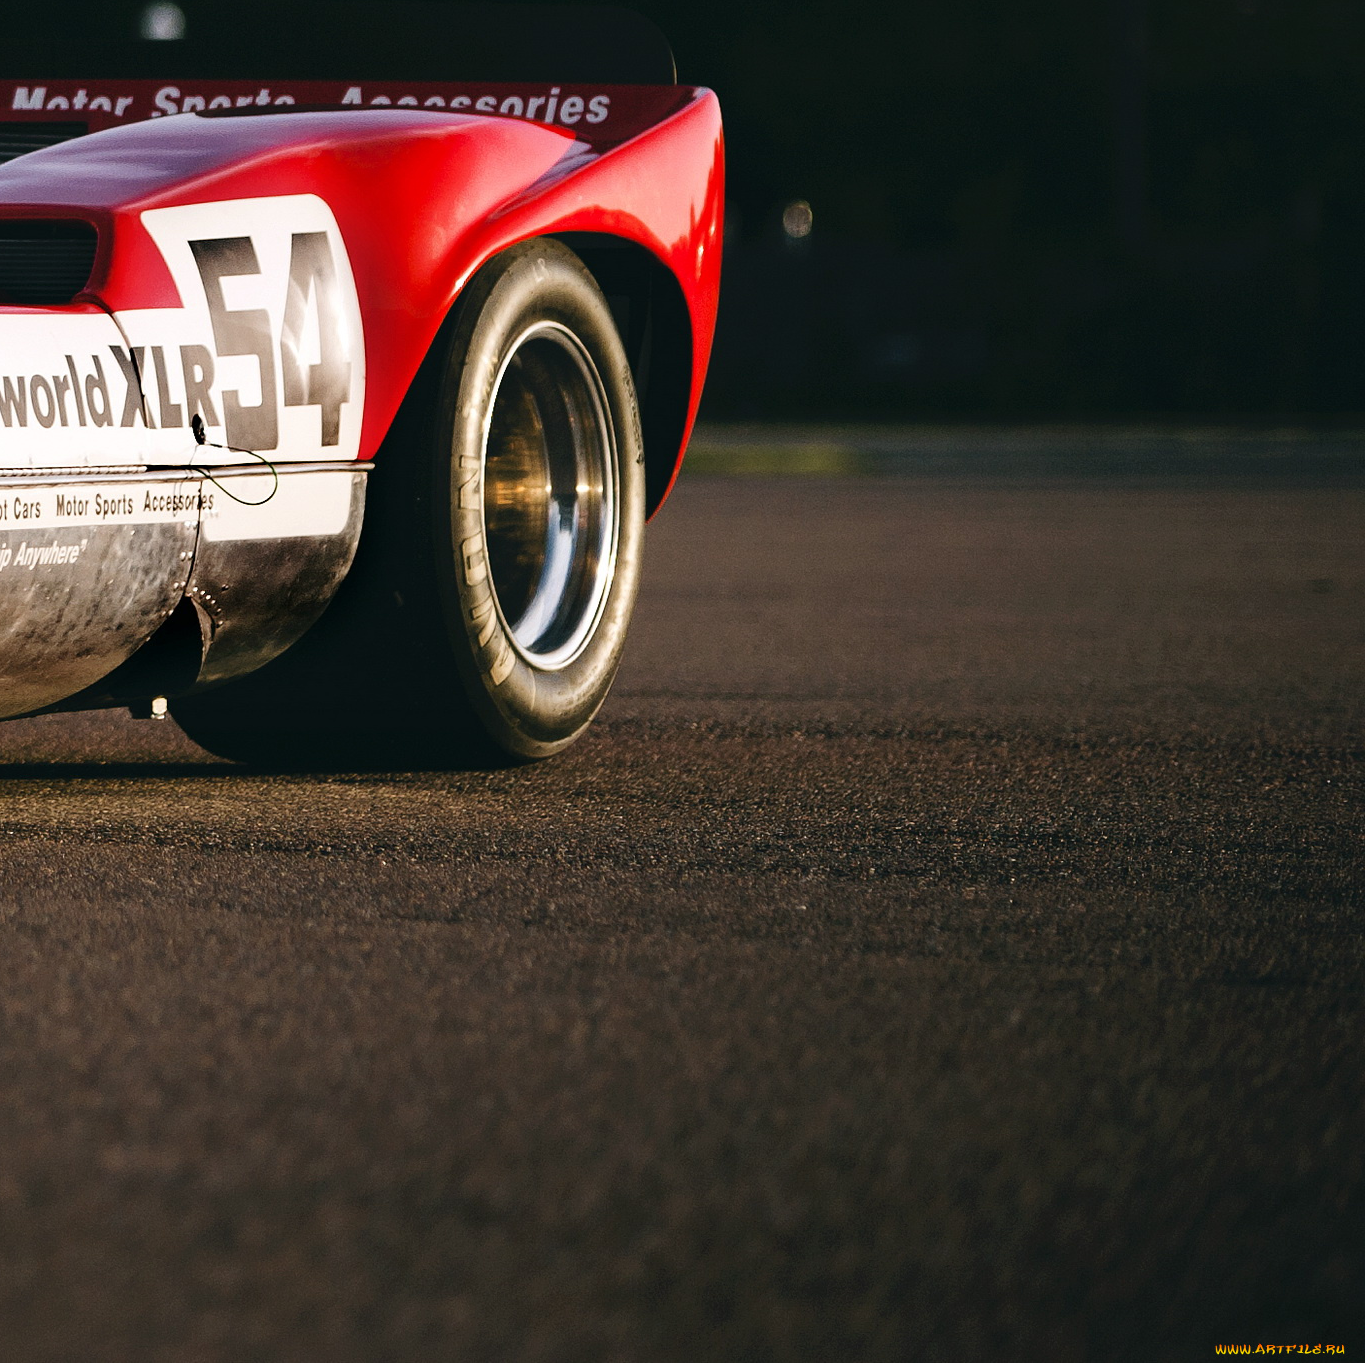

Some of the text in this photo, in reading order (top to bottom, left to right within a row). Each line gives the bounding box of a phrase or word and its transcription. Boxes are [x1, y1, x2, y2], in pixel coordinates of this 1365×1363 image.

[187, 231, 351, 452] 54
[108, 344, 221, 429] XLR
[13, 497, 42, 520] Cars
[56, 494, 90, 517] Motor
[95, 493, 134, 519] Sports
[143, 490, 215, 512] Accessories
